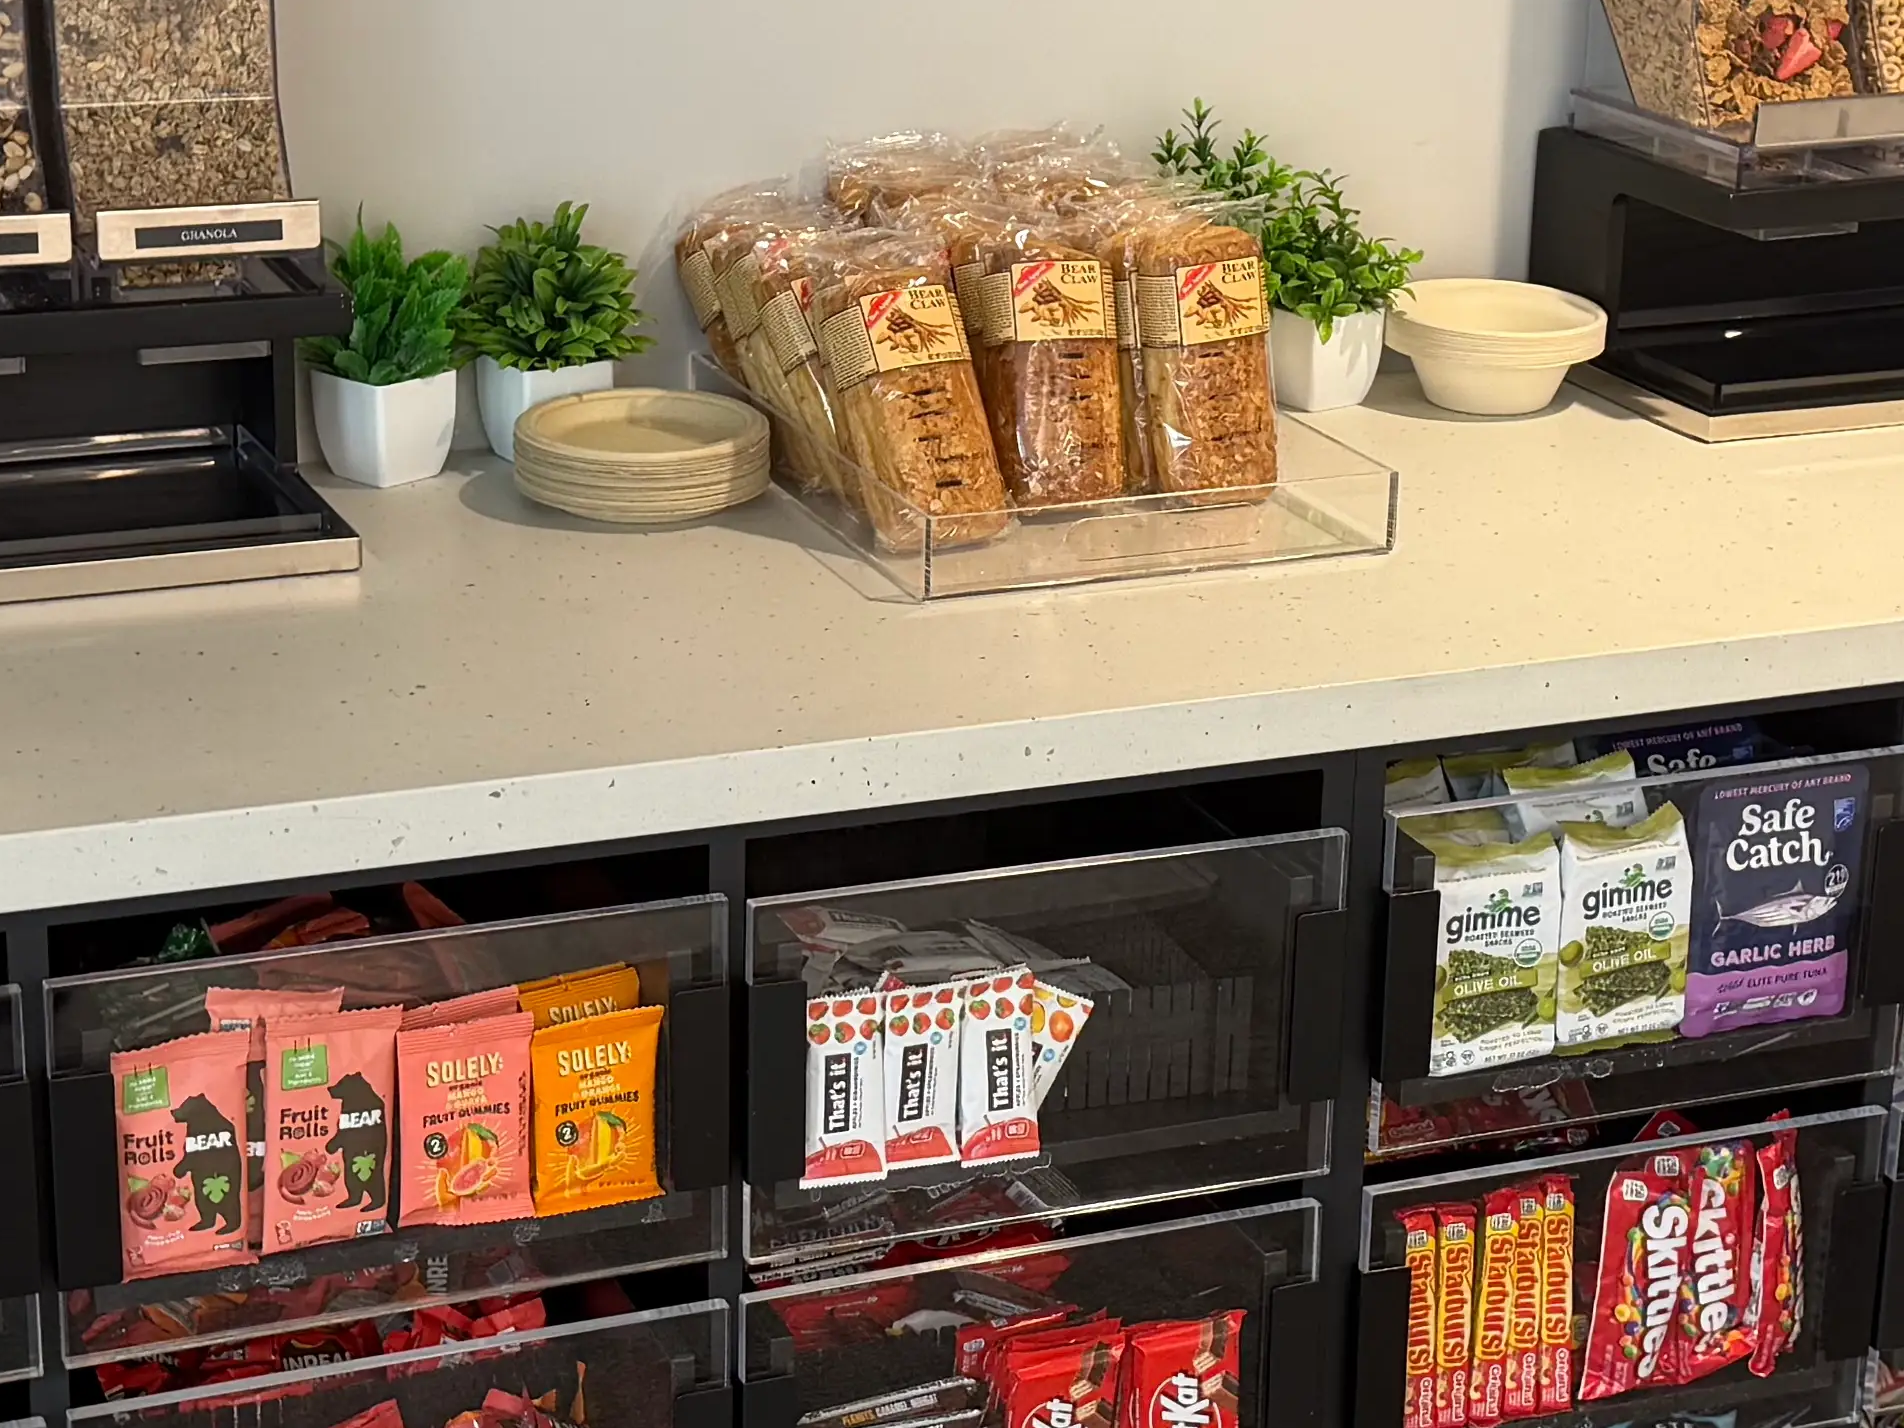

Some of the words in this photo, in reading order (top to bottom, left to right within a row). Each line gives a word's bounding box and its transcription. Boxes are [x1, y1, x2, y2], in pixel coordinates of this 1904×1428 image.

[180, 227, 238, 241] GRANOLA
[1061, 272, 1098, 284] CLAW
[1222, 270, 1257, 283] CLAW
[1714, 786, 1748, 800] LOWEST
[1750, 782, 1790, 796] MERCURY
[1791, 780, 1803, 790] OF
[1804, 777, 1820, 788] ANY
[1823, 774, 1852, 785] BRAND
[1738, 798, 1816, 836] Safe
[1726, 831, 1830, 872] Catch
[1582, 881, 1673, 921] gimme
[1446, 905, 1541, 945] gimme
[1592, 954, 1629, 973] OLIVE
[1633, 947, 1656, 960] OIL
[1710, 943, 1781, 968] GARLIC
[1788, 935, 1835, 958] HERB
[1454, 977, 1493, 996] OLIVE
[1498, 974, 1523, 988] OIL
[1746, 976, 1773, 989] ELITE
[1774, 972, 1798, 984] PURE
[1802, 967, 1827, 979] TUNA
[555, 1099, 586, 1116] FRUIT
[589, 1090, 640, 1107] GUMMIES
[279, 1105, 329, 1124] Fruit
[338, 1109, 382, 1130] BEAR
[423, 1111, 455, 1128] FRUIT
[459, 1103, 510, 1119] GUMMIES
[122, 1130, 174, 1150] Fruit
[185, 1131, 232, 1153] BEAR
[279, 1122, 329, 1141] Rolls
[124, 1148, 176, 1166] Rolls
